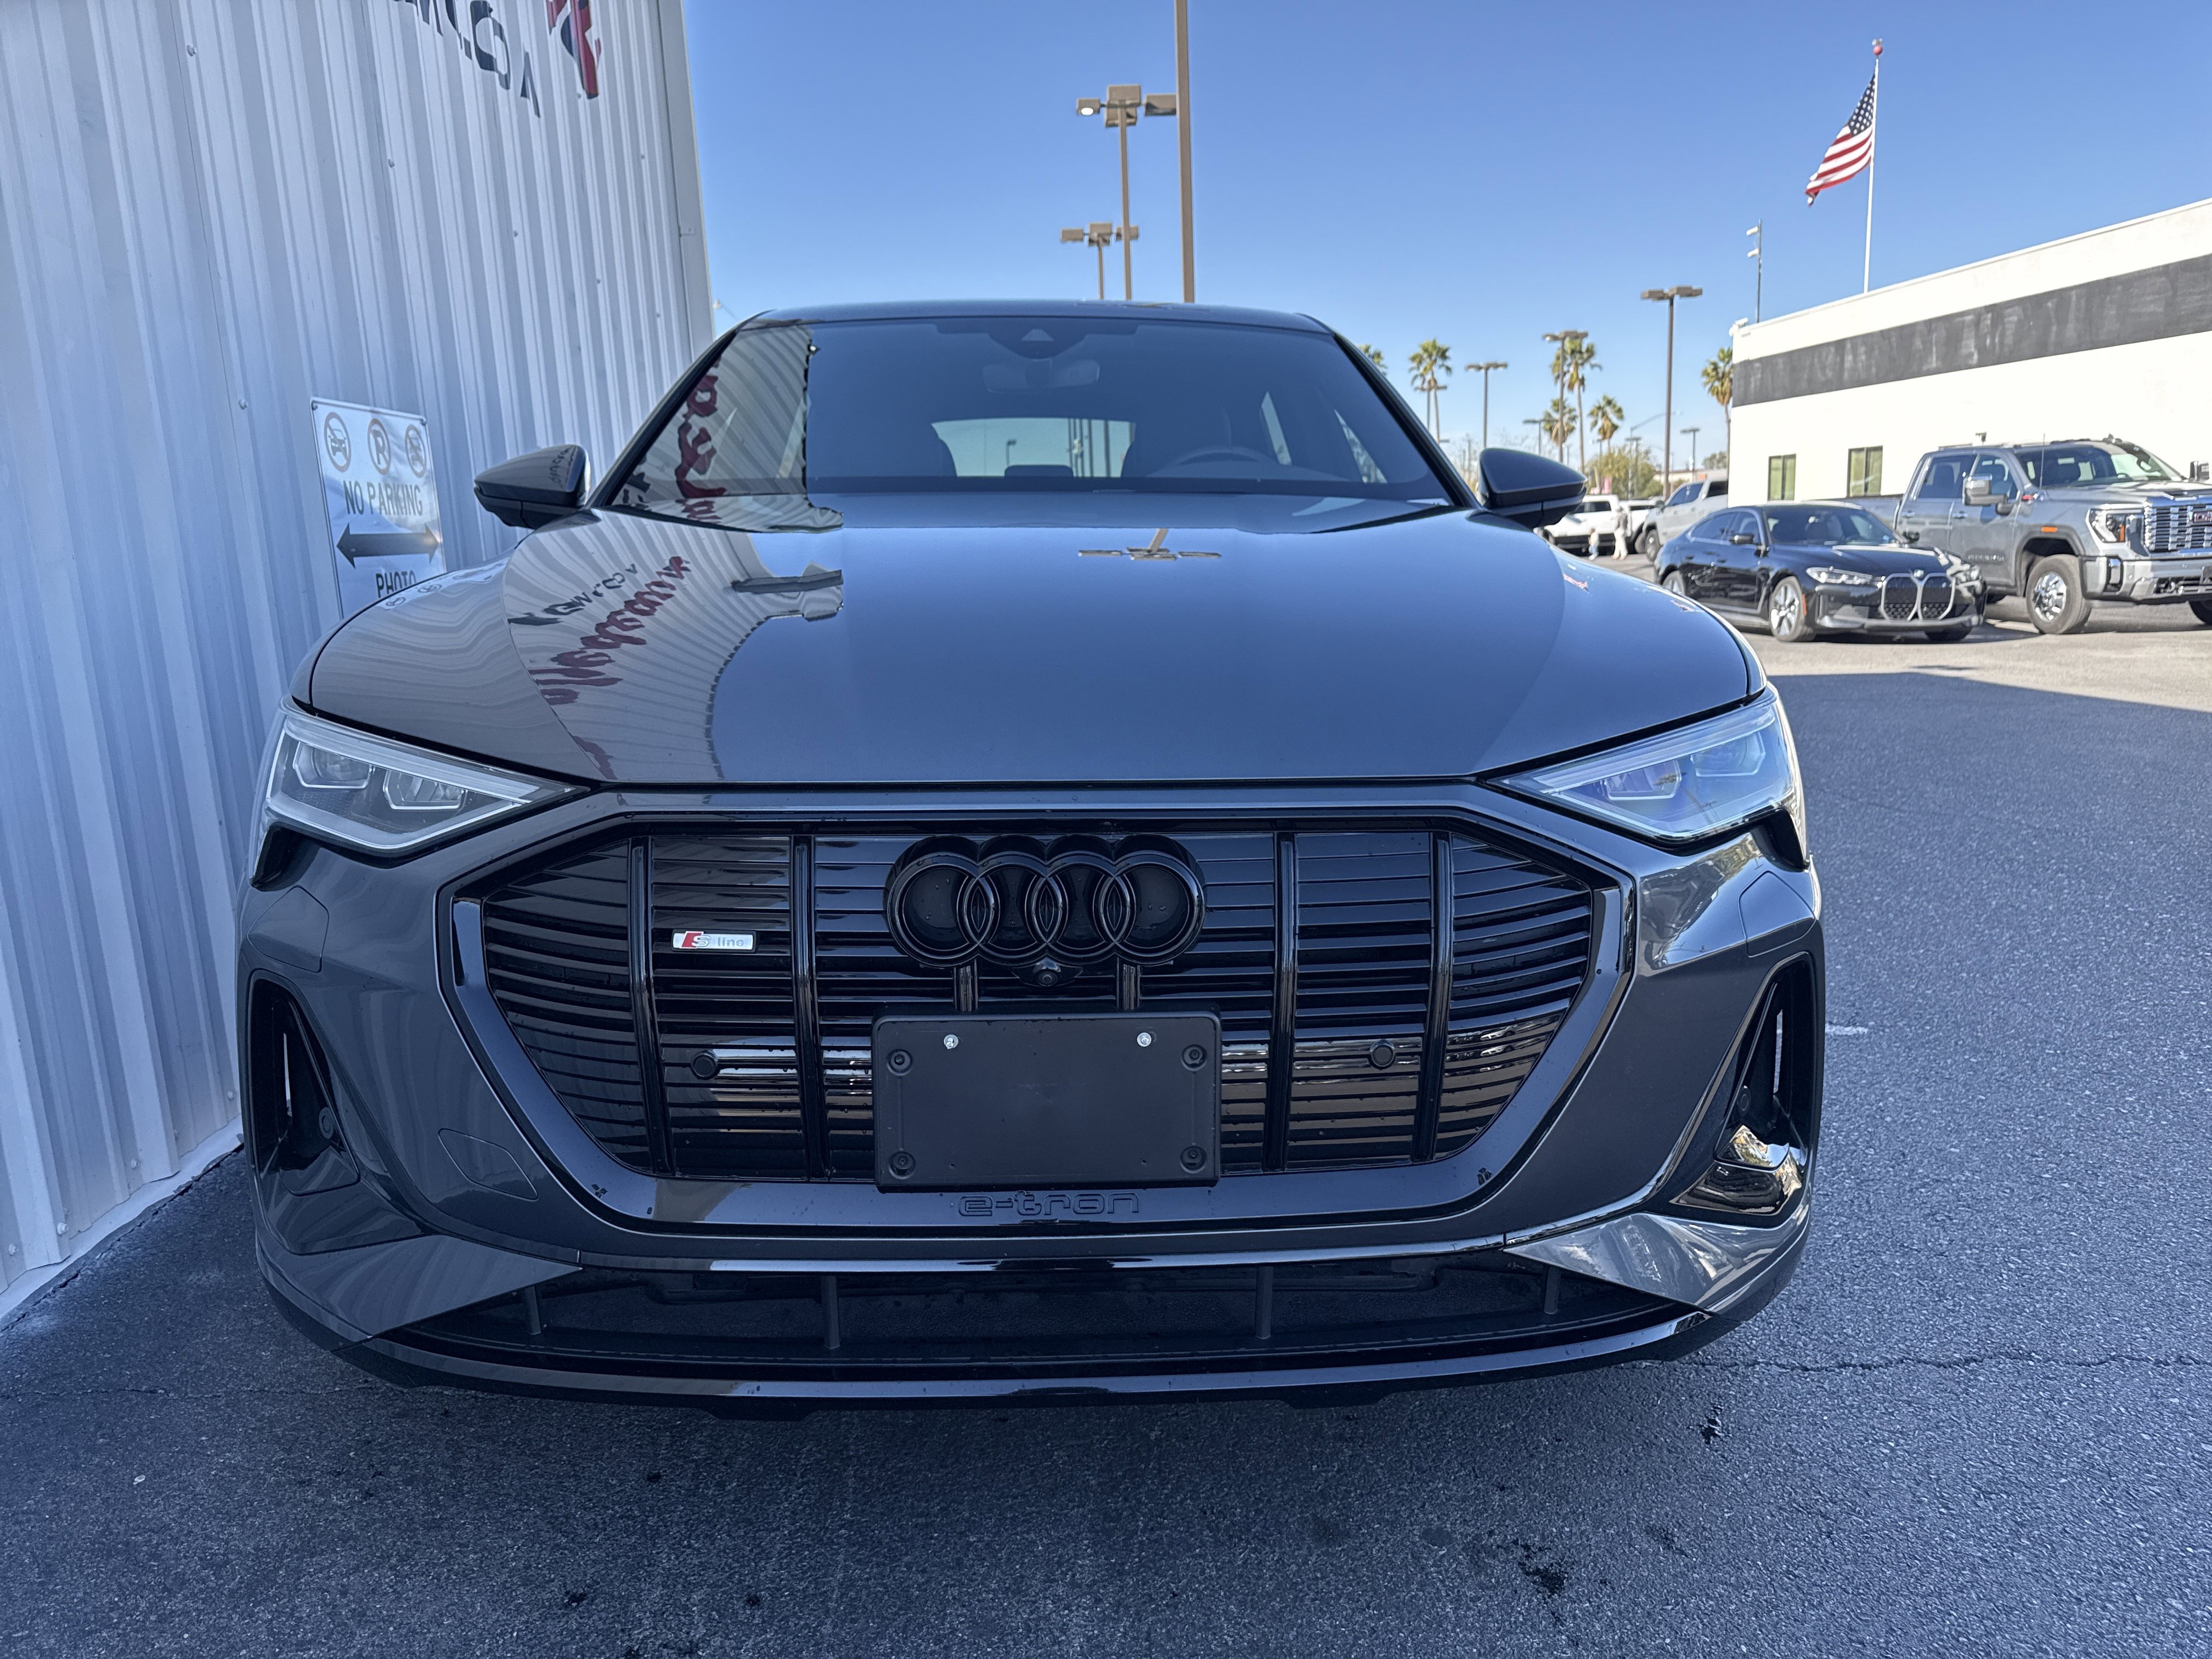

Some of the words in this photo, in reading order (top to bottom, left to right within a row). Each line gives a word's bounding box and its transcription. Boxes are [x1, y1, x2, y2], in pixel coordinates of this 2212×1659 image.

[343, 480, 364, 515] NO
[366, 482, 422, 516] PARKING
[689, 934, 712, 948] S
[958, 1190, 1139, 1217] e-tron
